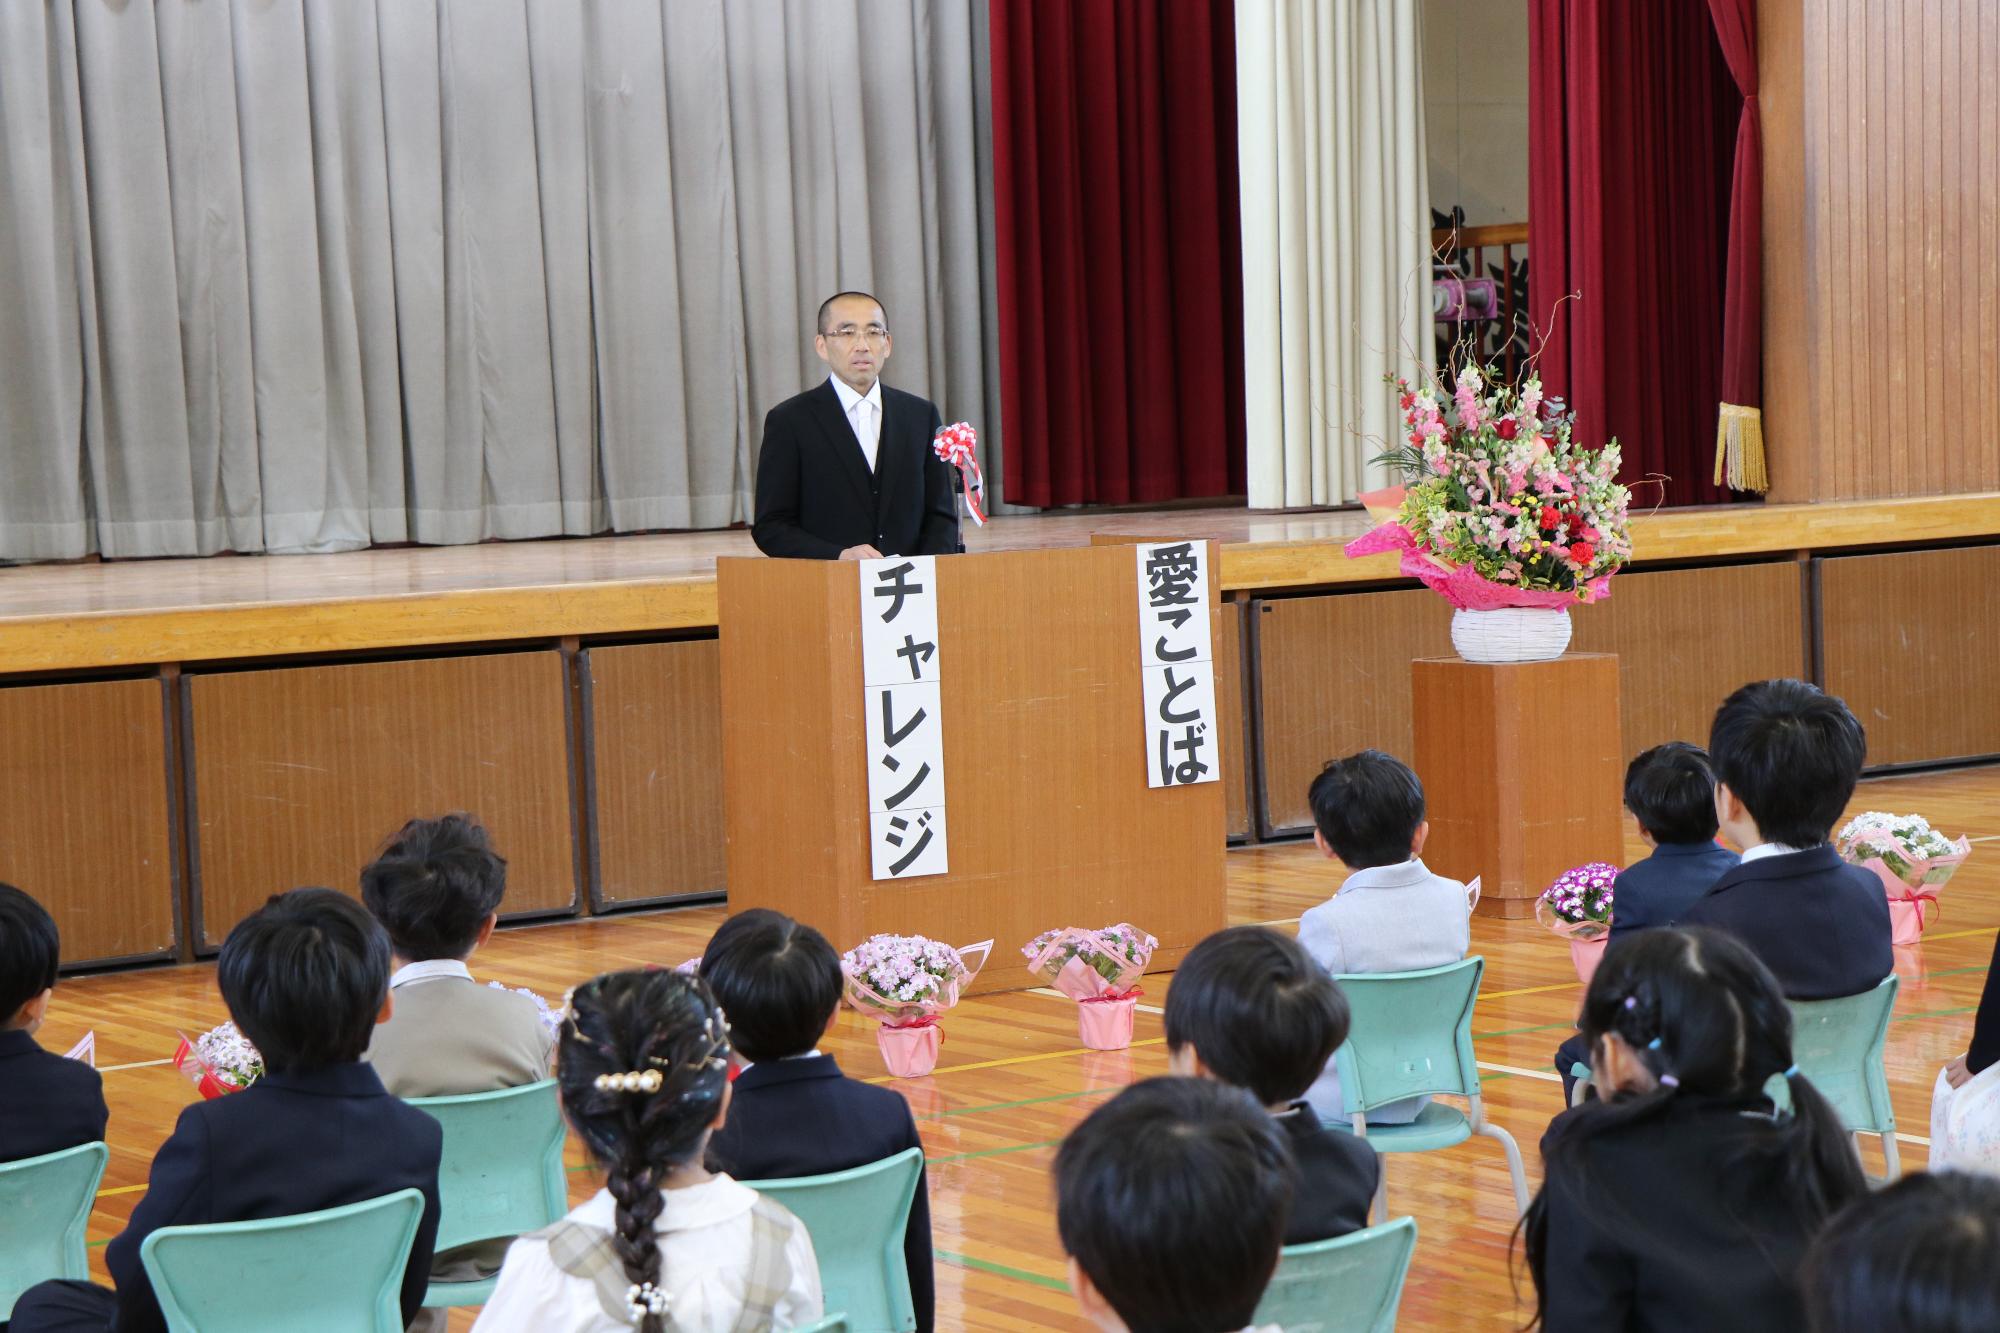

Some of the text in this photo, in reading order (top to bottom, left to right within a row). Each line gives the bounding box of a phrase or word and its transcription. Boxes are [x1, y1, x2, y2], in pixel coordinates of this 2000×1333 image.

[874, 562, 936, 876] チャレンジ
[1146, 543, 1208, 786] 愛ことば
